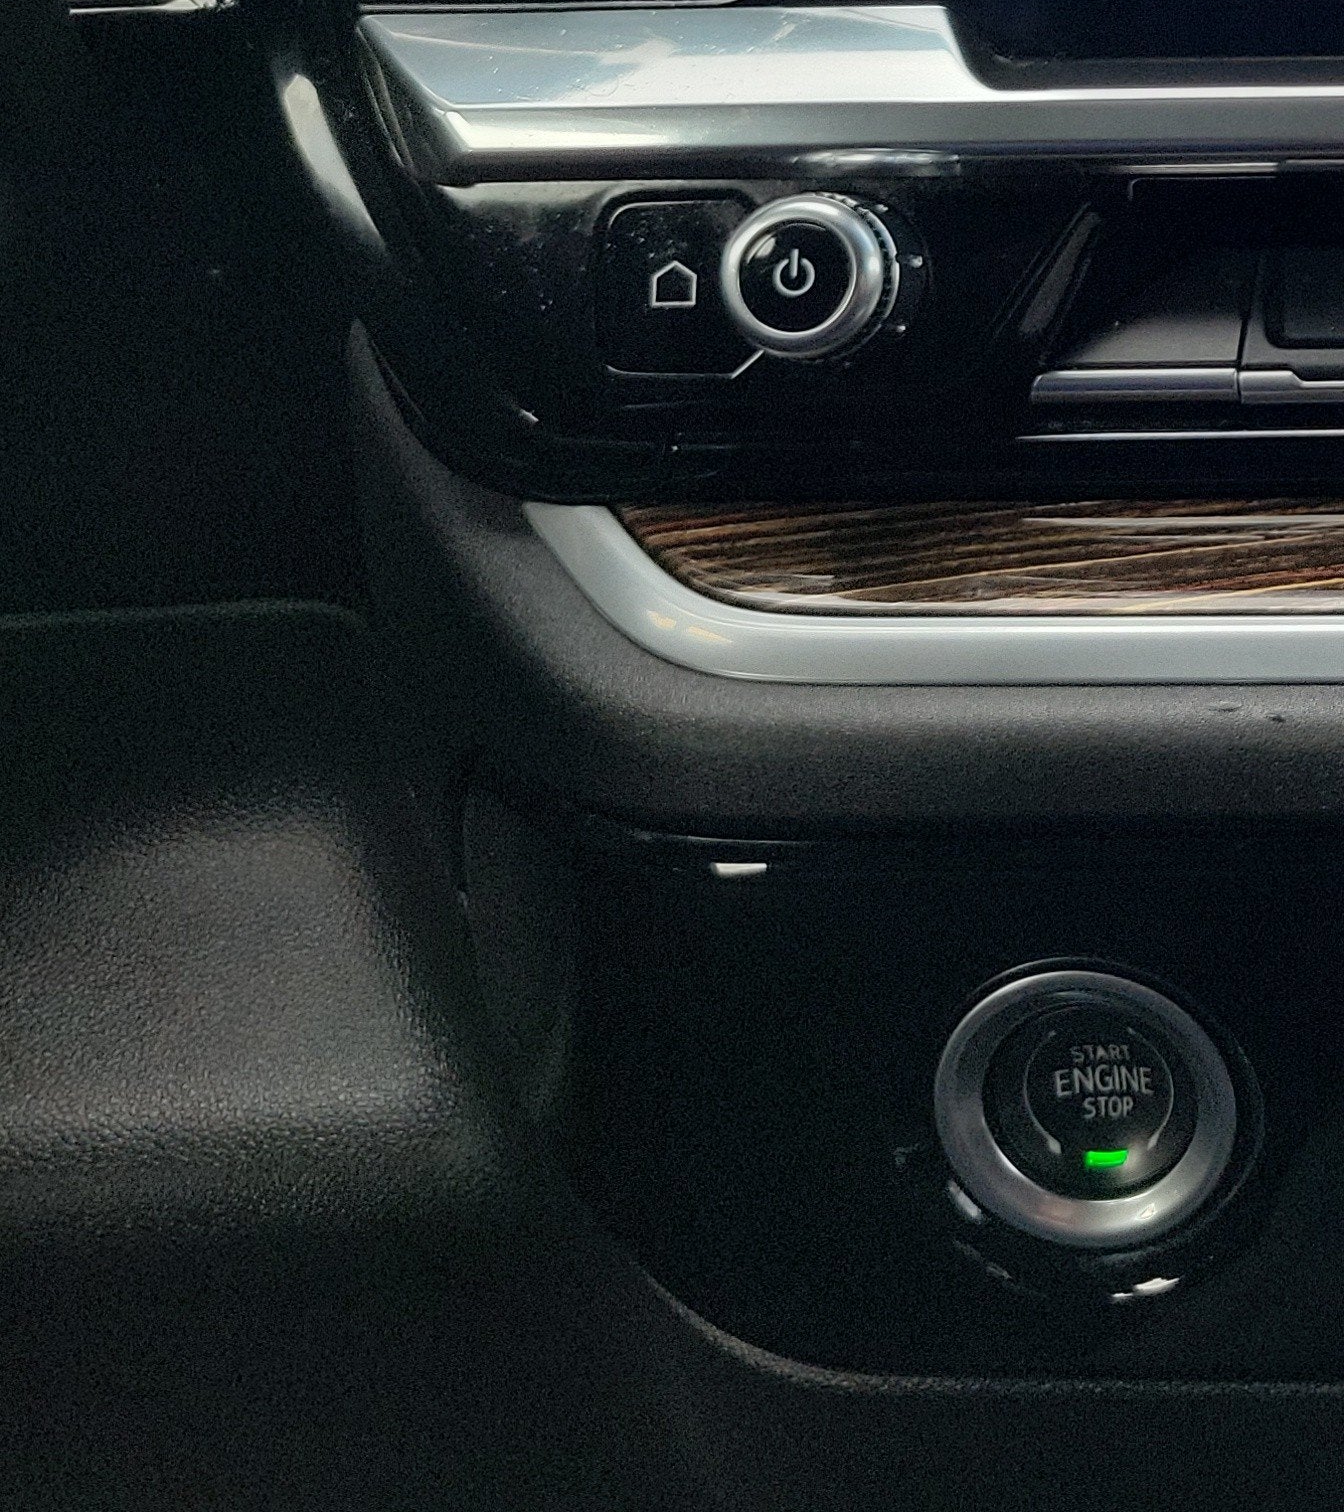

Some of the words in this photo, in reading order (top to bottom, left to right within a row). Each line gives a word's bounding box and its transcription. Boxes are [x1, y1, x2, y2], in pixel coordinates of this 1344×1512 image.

[1070, 1044, 1130, 1064] START
[1055, 1066, 1154, 1098] ENGINE
[1082, 1096, 1134, 1120] STOP
